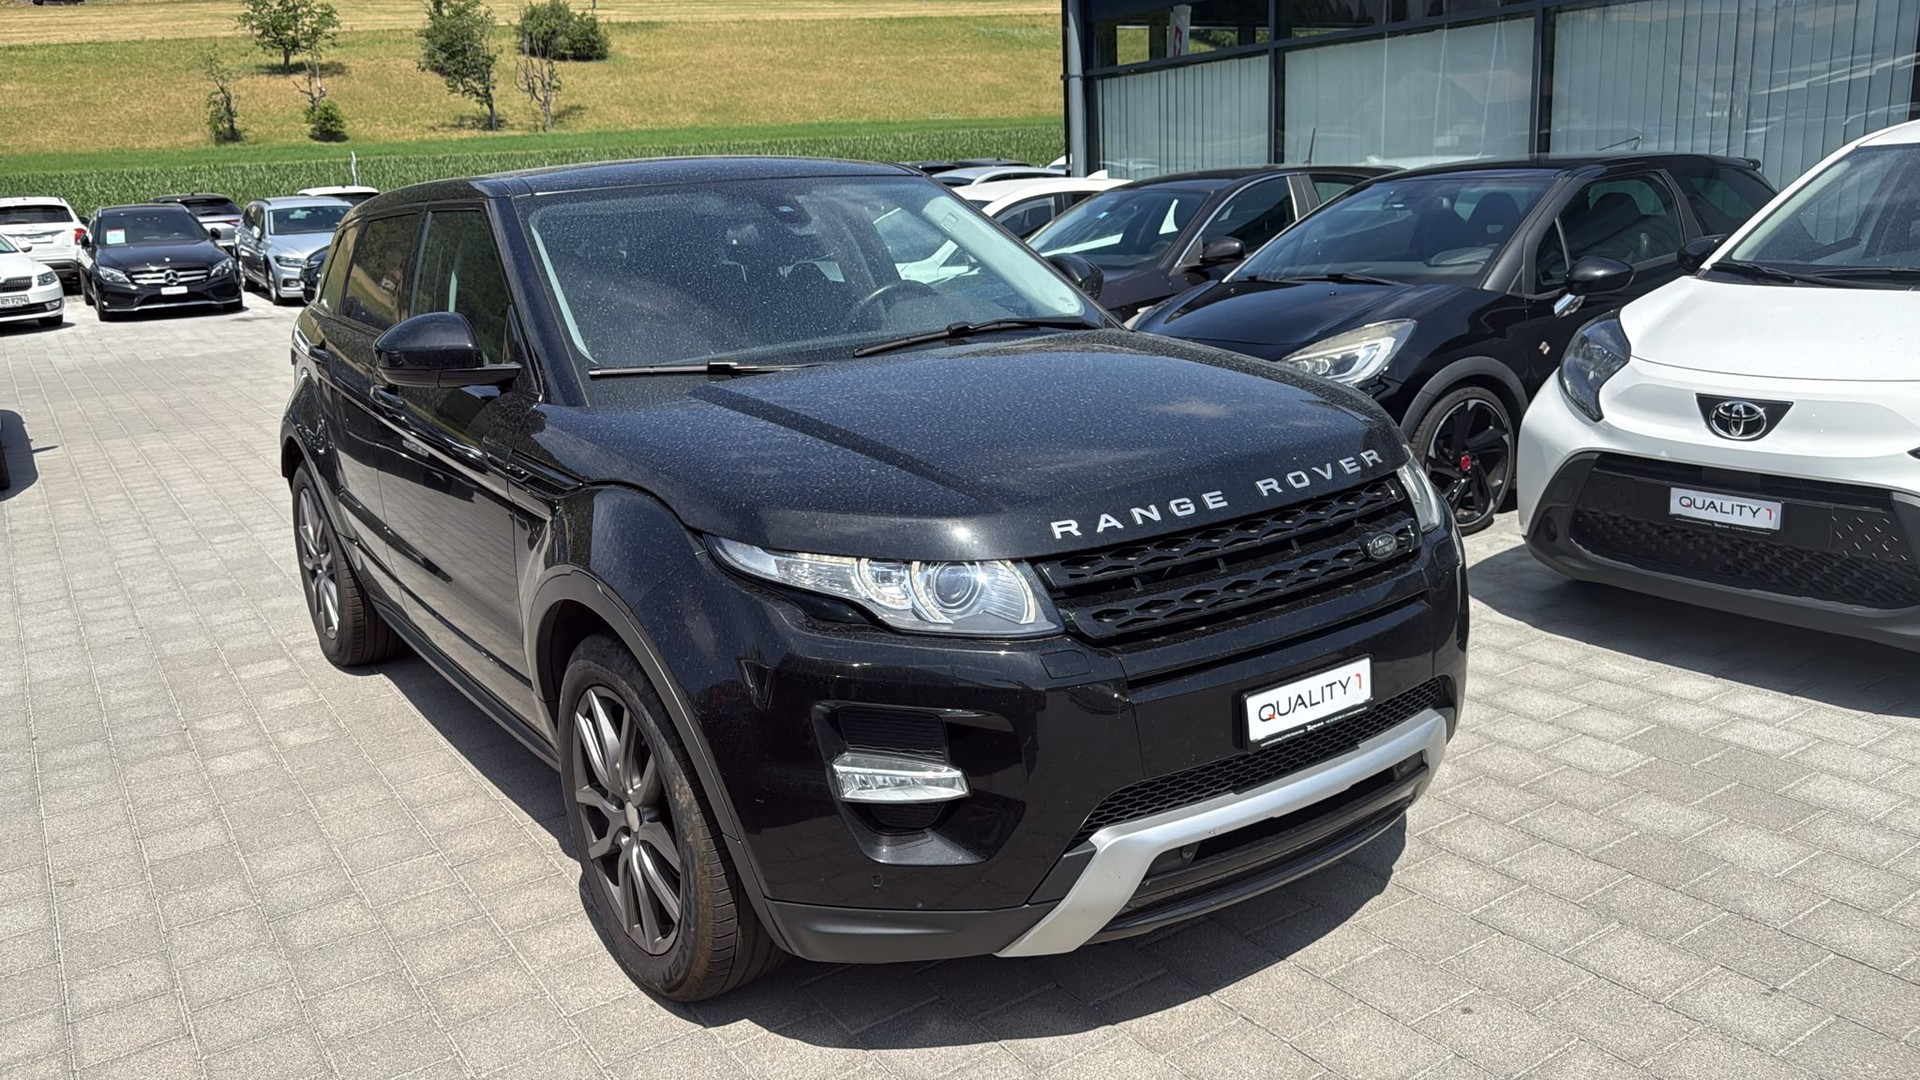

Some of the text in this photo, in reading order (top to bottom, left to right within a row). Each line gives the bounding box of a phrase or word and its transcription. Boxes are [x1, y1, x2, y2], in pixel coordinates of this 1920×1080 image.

[1050, 449, 1383, 539] RANGE ROVER
[1679, 495, 1772, 521] QUALITY 1
[1258, 673, 1362, 722] QUALITY 1
